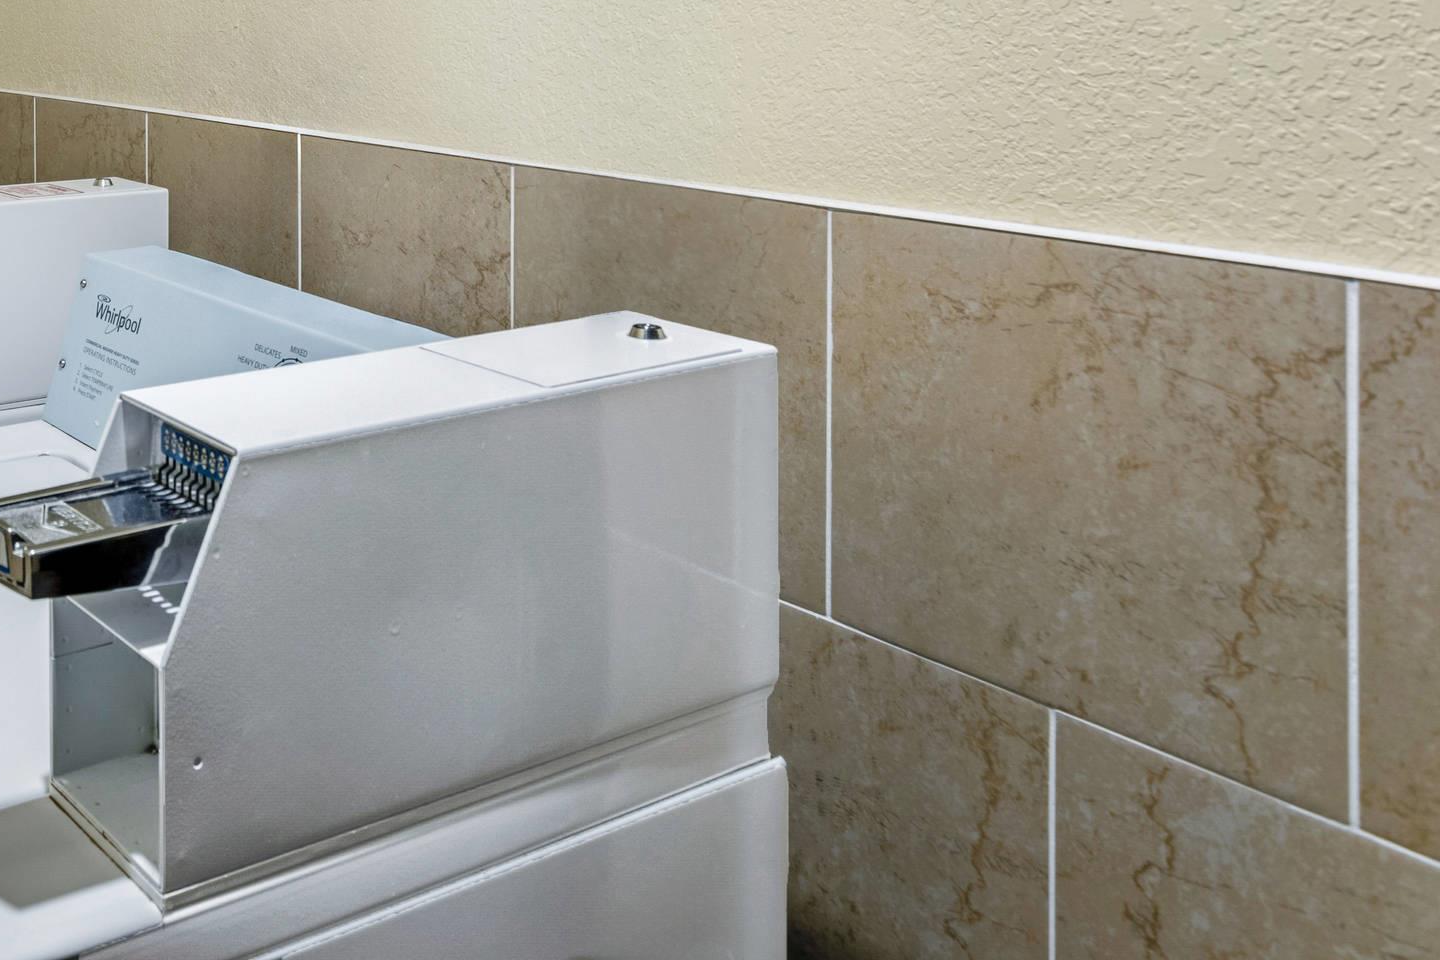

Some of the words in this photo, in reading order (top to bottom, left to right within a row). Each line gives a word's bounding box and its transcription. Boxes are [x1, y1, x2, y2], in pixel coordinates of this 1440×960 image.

[95, 301, 142, 335] Whirlpool
[254, 343, 282, 360] DELICATES
[290, 345, 309, 359] MIXED
